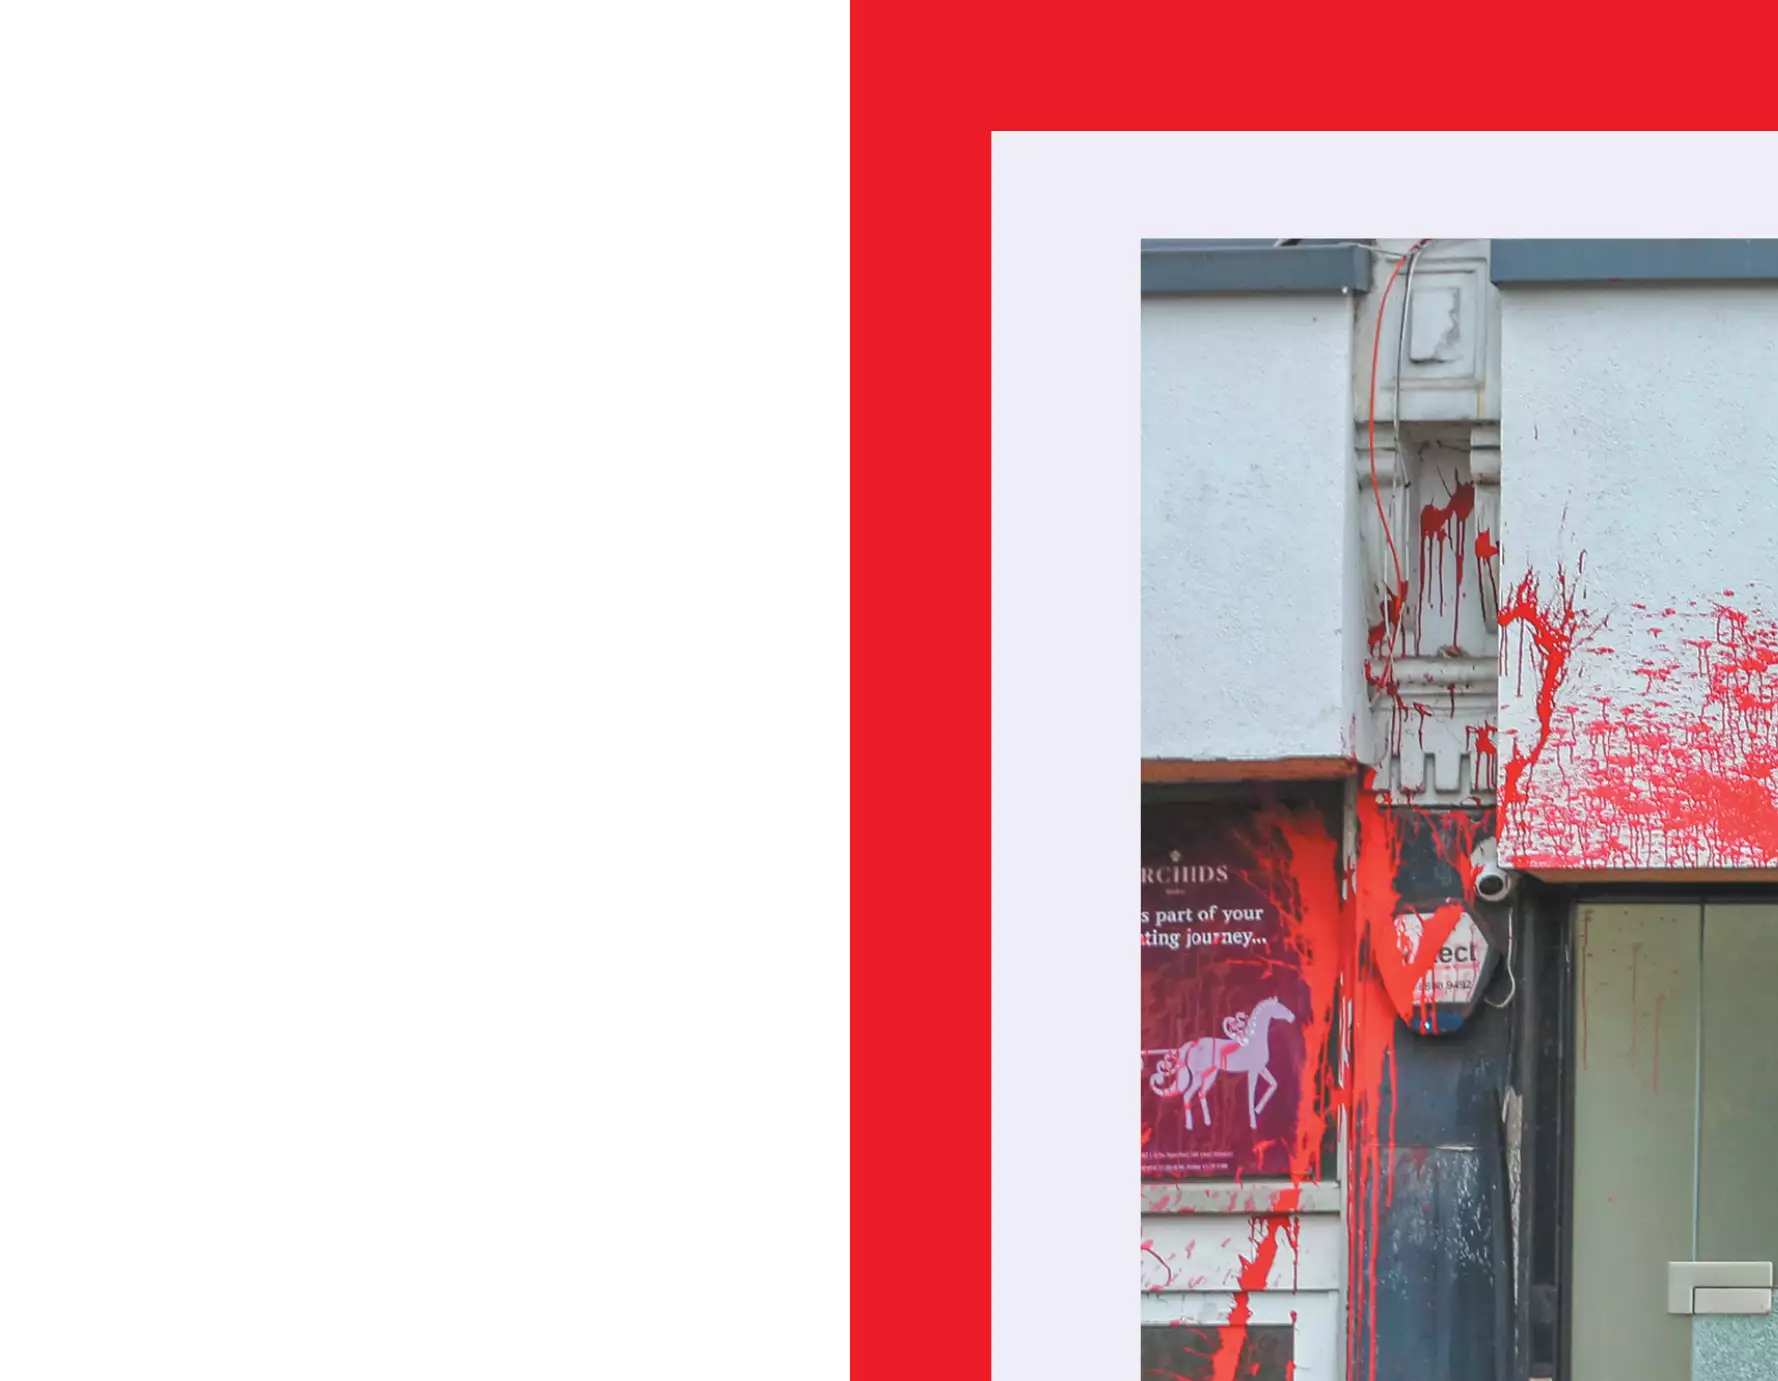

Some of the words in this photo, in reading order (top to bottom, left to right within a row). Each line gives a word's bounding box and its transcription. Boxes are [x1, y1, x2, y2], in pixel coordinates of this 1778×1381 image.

[1156, 907, 1193, 928] part
[1197, 905, 1218, 922] of
[1222, 908, 1264, 925] your
